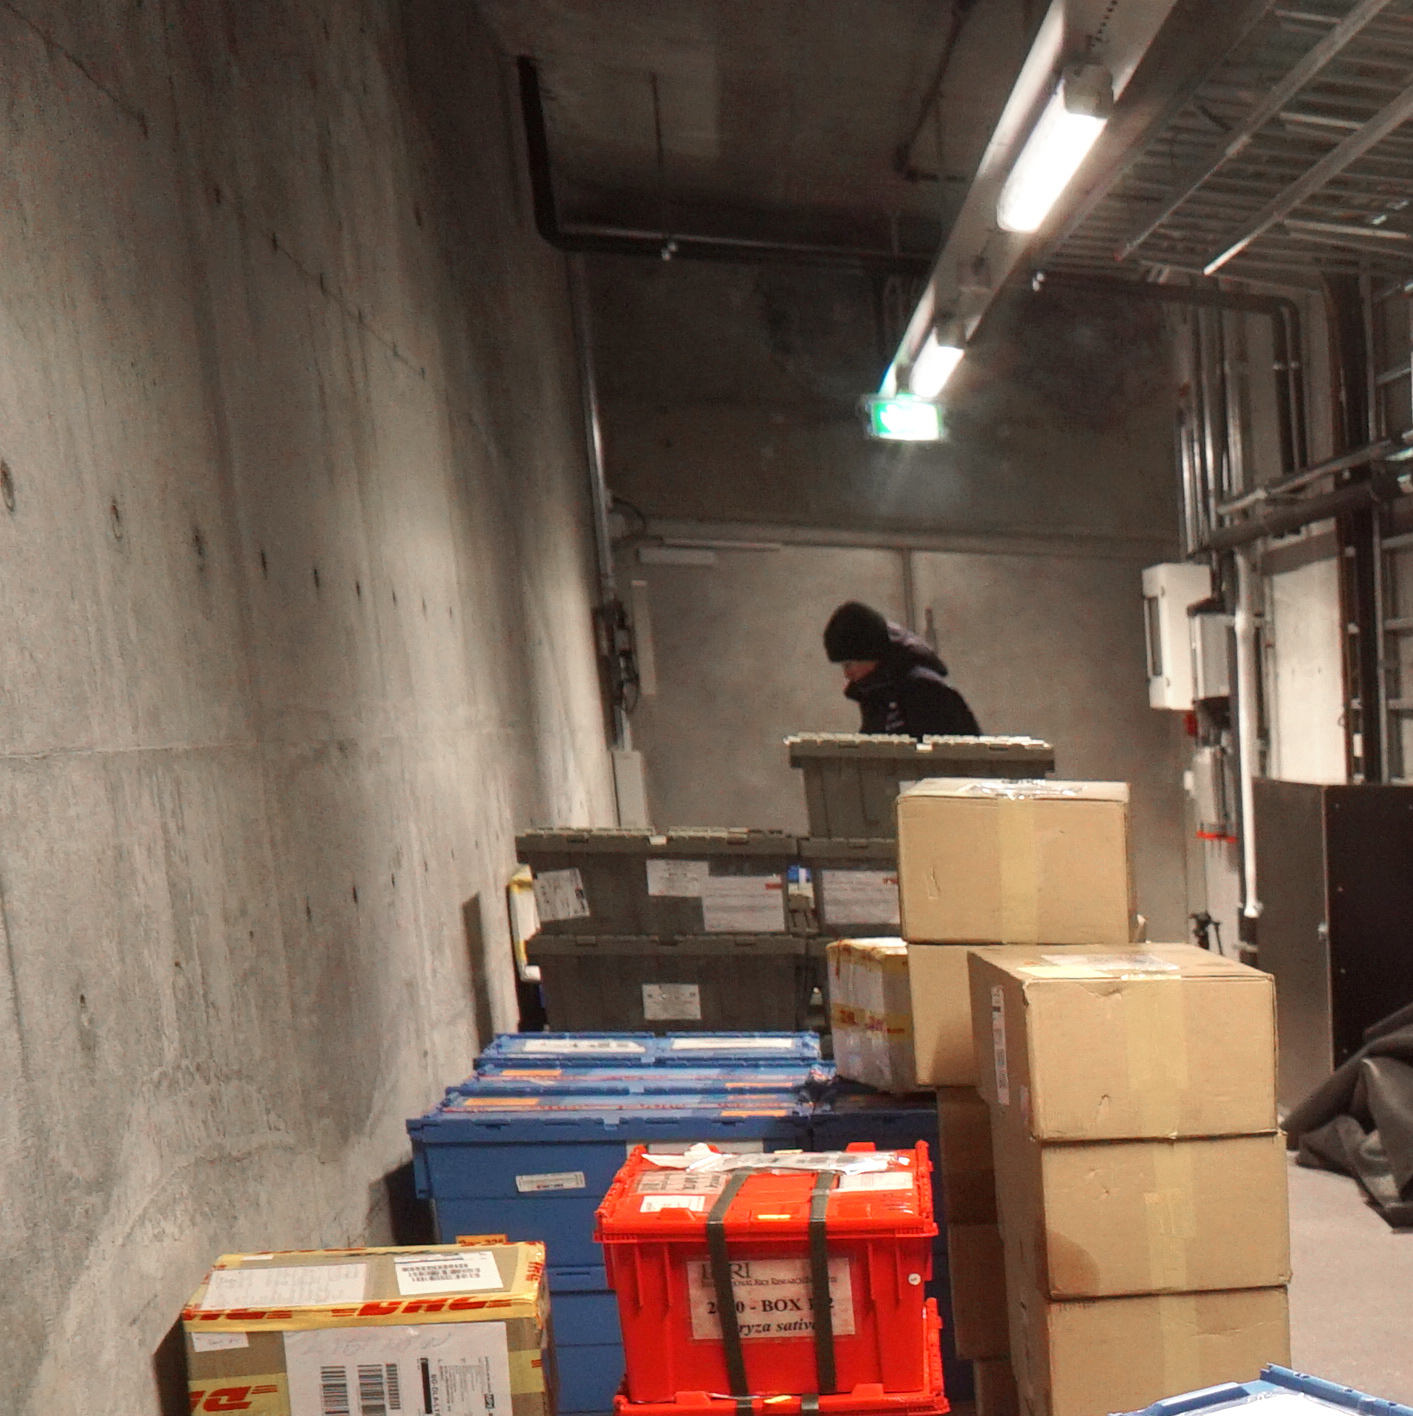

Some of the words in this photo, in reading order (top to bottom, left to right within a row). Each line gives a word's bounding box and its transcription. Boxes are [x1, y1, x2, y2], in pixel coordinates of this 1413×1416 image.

[702, 1262, 752, 1280] IRI
[706, 1299, 746, 1315] 20
[762, 1298, 801, 1314] BOX
[738, 1321, 772, 1336] ryza
